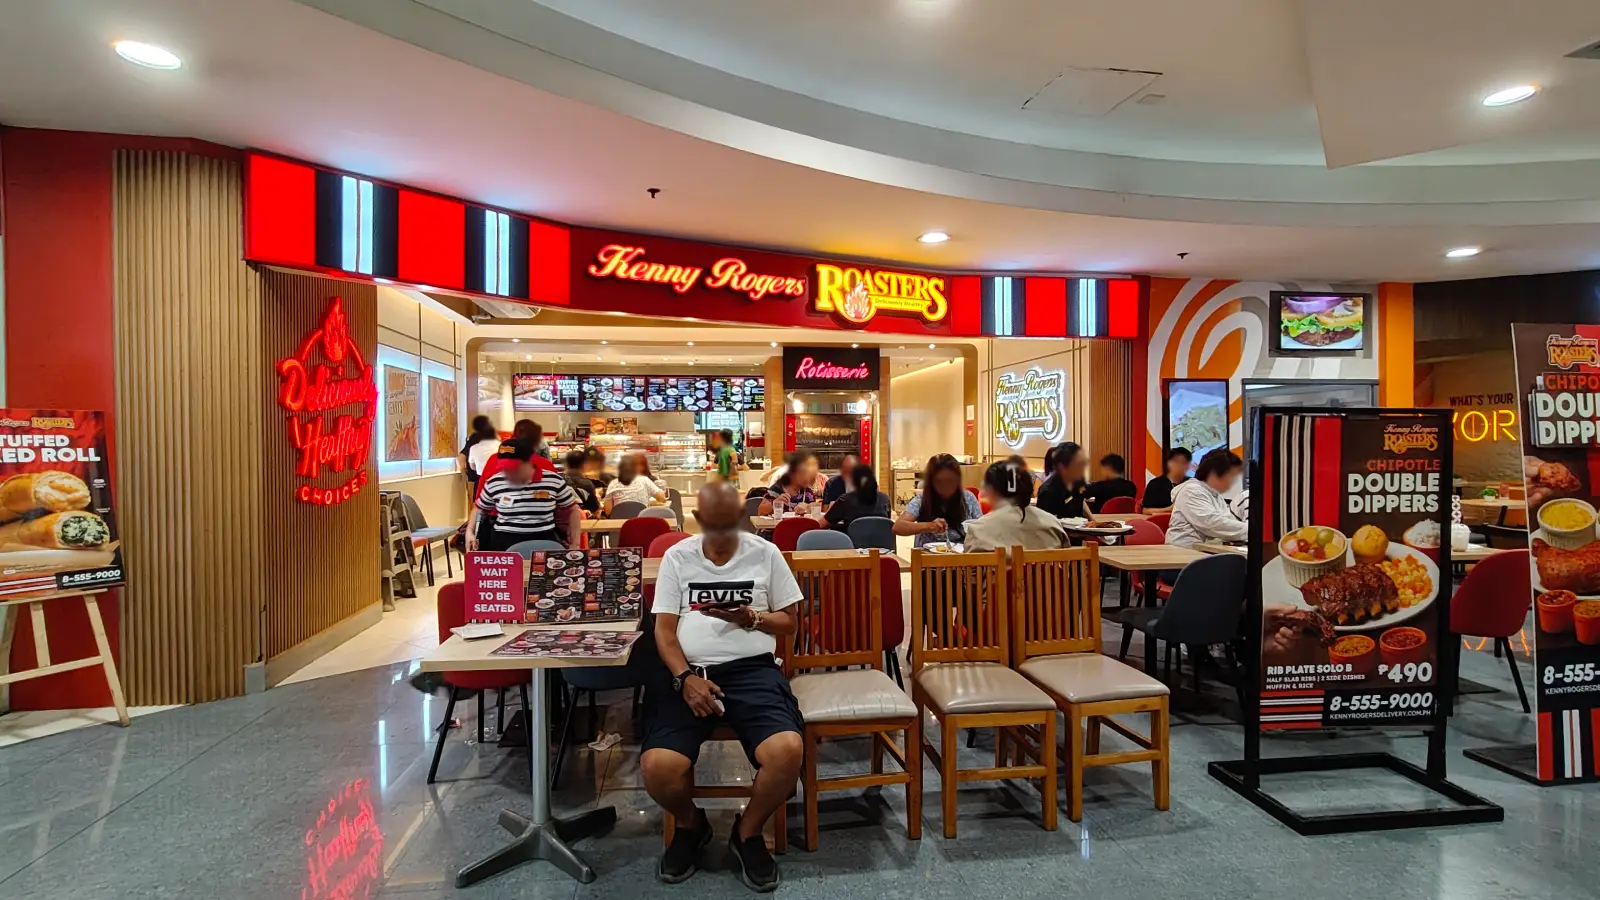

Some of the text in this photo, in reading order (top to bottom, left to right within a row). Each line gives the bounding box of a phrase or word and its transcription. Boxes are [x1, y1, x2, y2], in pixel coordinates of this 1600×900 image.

[588, 244, 805, 301] Kenny Rogers
[815, 263, 948, 323] ROASTERS
[795, 357, 870, 379] Rotisserie
[1449, 393, 1514, 406] WHAT'S YOUR
[996, 397, 1061, 444] ROASTERS
[298, 415, 371, 478] Healthy
[1383, 433, 1438, 454] ROASTERS
[41, 447, 101, 462] ROLL
[1367, 460, 1441, 471] CHIPOTLE
[301, 470, 367, 505] CHOICES
[1347, 472, 1440, 493] DOUBLE
[1348, 494, 1439, 513] DIPPERS
[474, 556, 514, 565] PLEASE
[62, 569, 121, 583] 8-555-9000
[480, 568, 508, 577] WAIT
[479, 580, 507, 589] HERE
[479, 592, 511, 601] TO BE
[474, 604, 515, 613] SEATED
[1267, 664, 1353, 675] RIB PLATE SOLO B
[1330, 692, 1434, 712] 8-555-9000
[1329, 710, 1432, 720] KENNYROGERSDELIVERY.COM.PH
